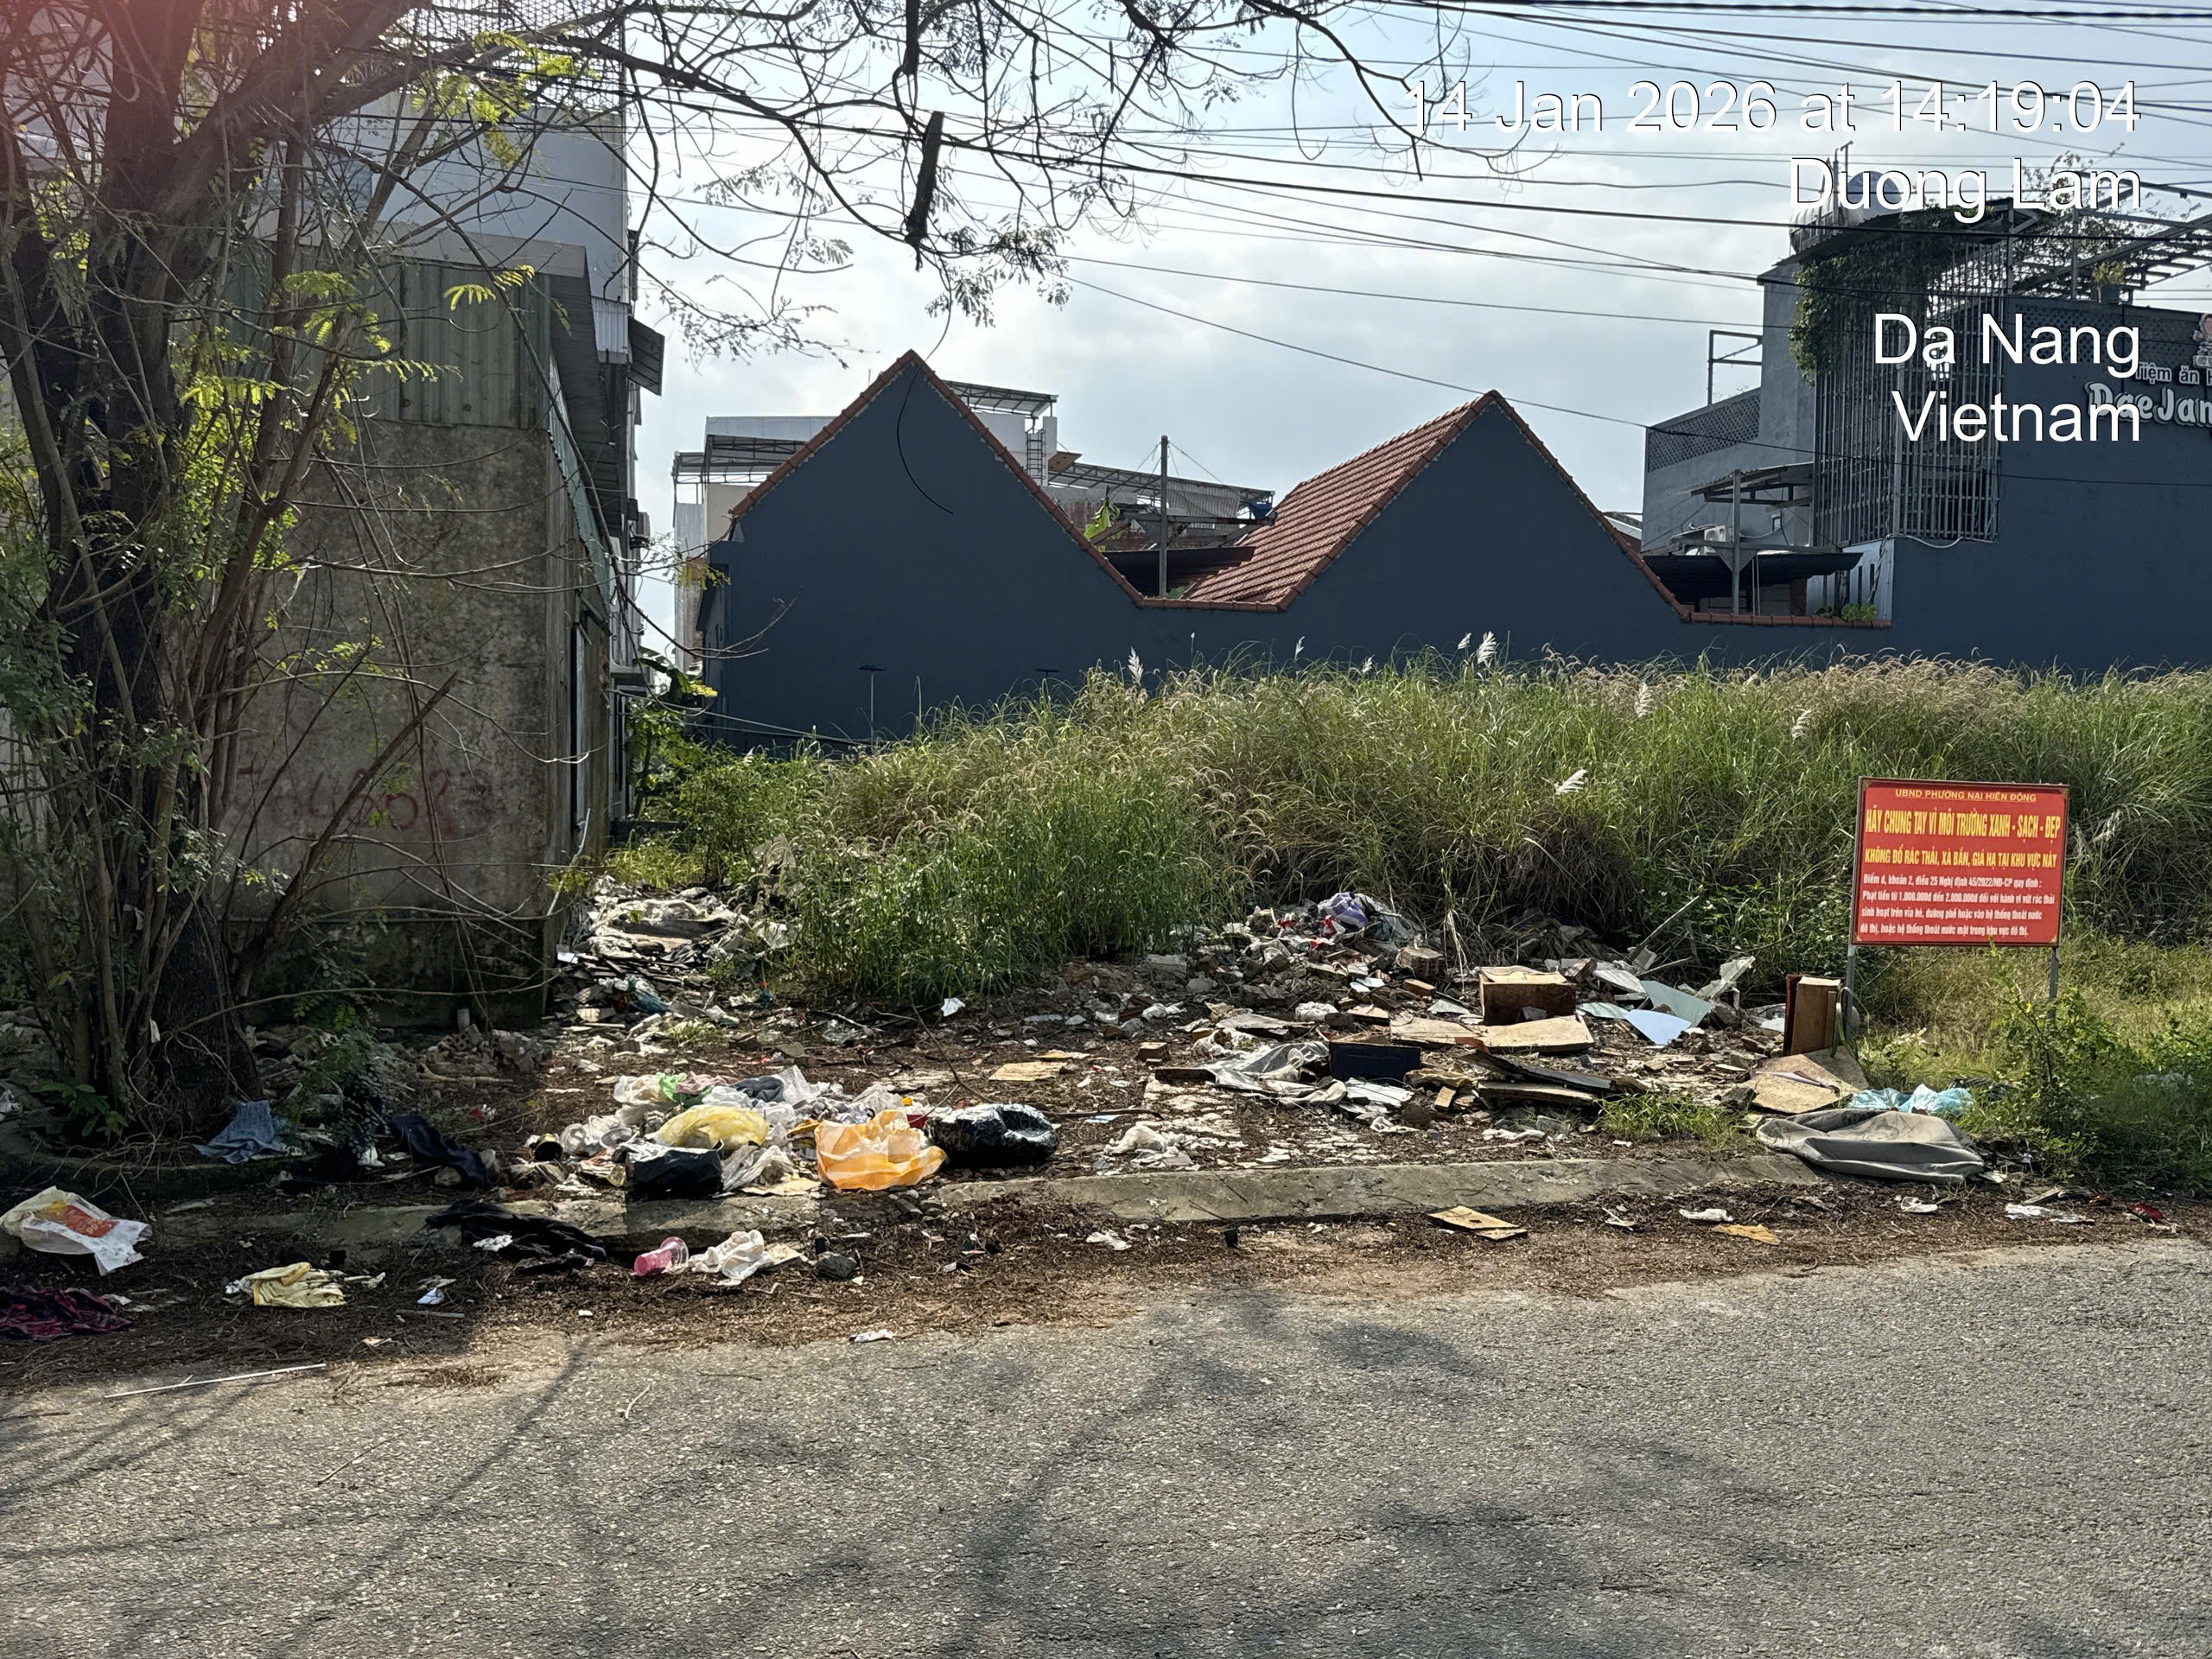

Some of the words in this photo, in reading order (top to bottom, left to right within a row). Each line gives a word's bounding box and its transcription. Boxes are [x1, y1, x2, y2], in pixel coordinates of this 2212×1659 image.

[2178, 365, 2200, 385] ăn
[1895, 789, 1923, 798] UBND
[1866, 804, 1883, 832] HÃY
[1884, 810, 1911, 834] CHUNG
[1914, 810, 1928, 834] TAY
[1929, 807, 1937, 835] VÌ
[1938, 807, 1955, 836] MÔI
[1956, 808, 1987, 836] TRƯỜNG
[1988, 814, 2011, 837] XANH
[2018, 815, 2039, 842] SẠCH
[2044, 816, 2061, 843] ĐẸP
[1865, 846, 1891, 863] KHÔNG
[1904, 847, 1919, 864] RÁC
[1986, 852, 1996, 870] HẠ
[1999, 852, 2009, 870] TẠI
[2011, 852, 2025, 867] KHU
[2027, 852, 2041, 870] VỰC
[2043, 851, 2057, 868] NÀY
[1930, 876, 1938, 886] 25
[2013, 880, 2024, 889] quy
